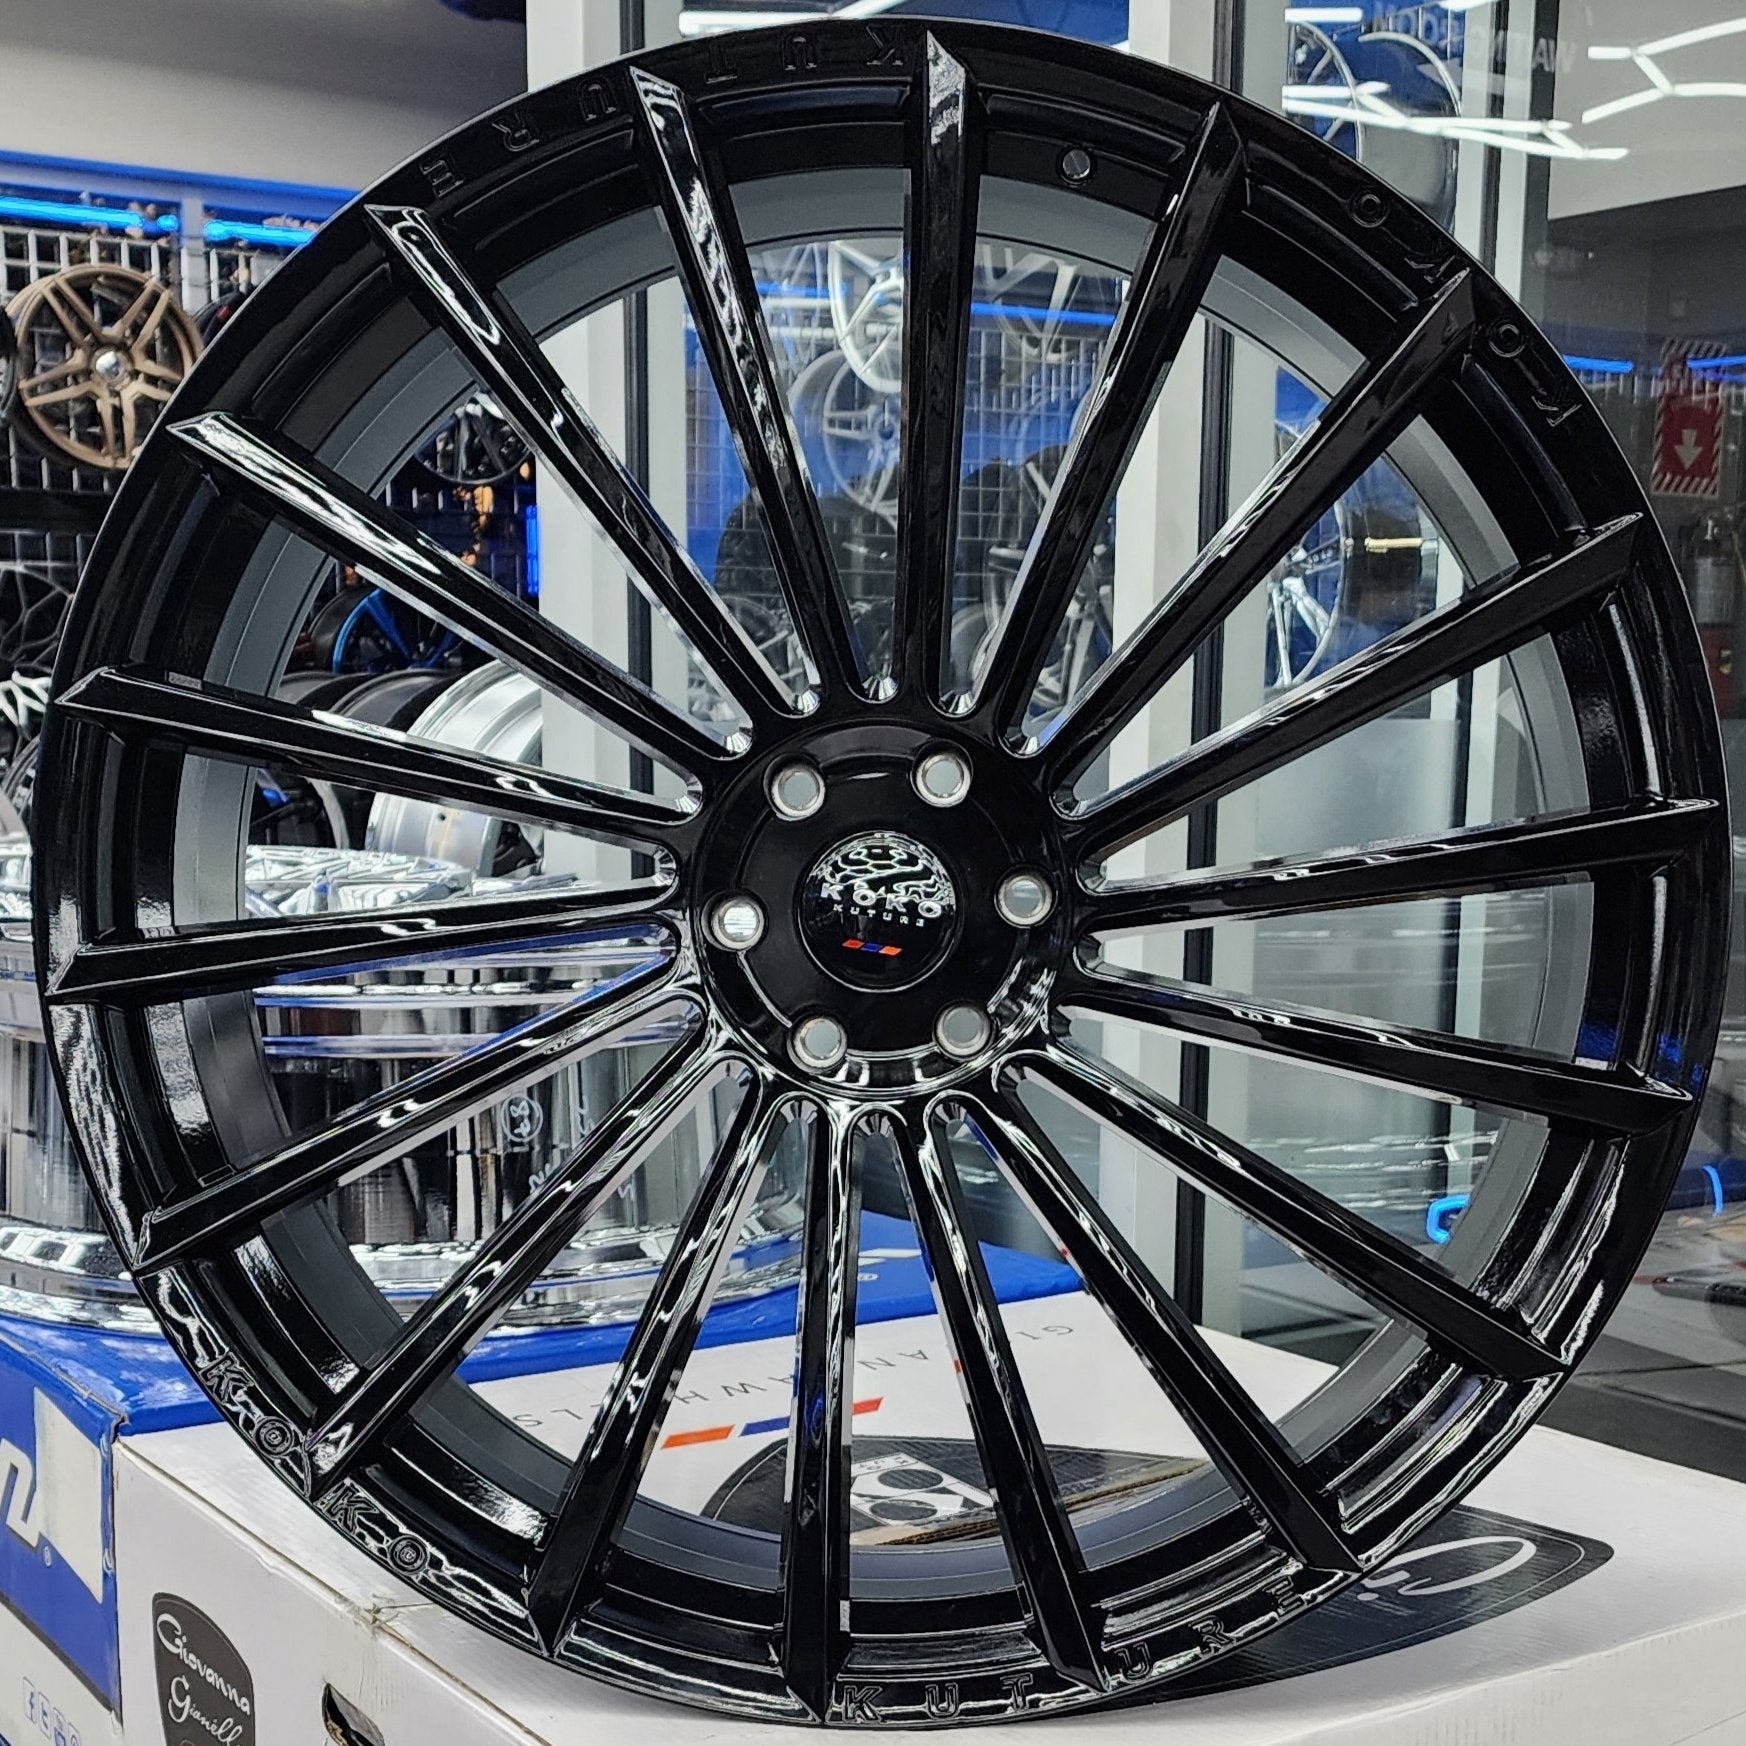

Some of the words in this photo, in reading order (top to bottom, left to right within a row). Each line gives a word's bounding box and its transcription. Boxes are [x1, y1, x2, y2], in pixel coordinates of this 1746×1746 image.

[820, 882, 942, 919] KOKO
[832, 903, 926, 928] KUTURE
[156, 1612, 251, 1716] Giovanna
